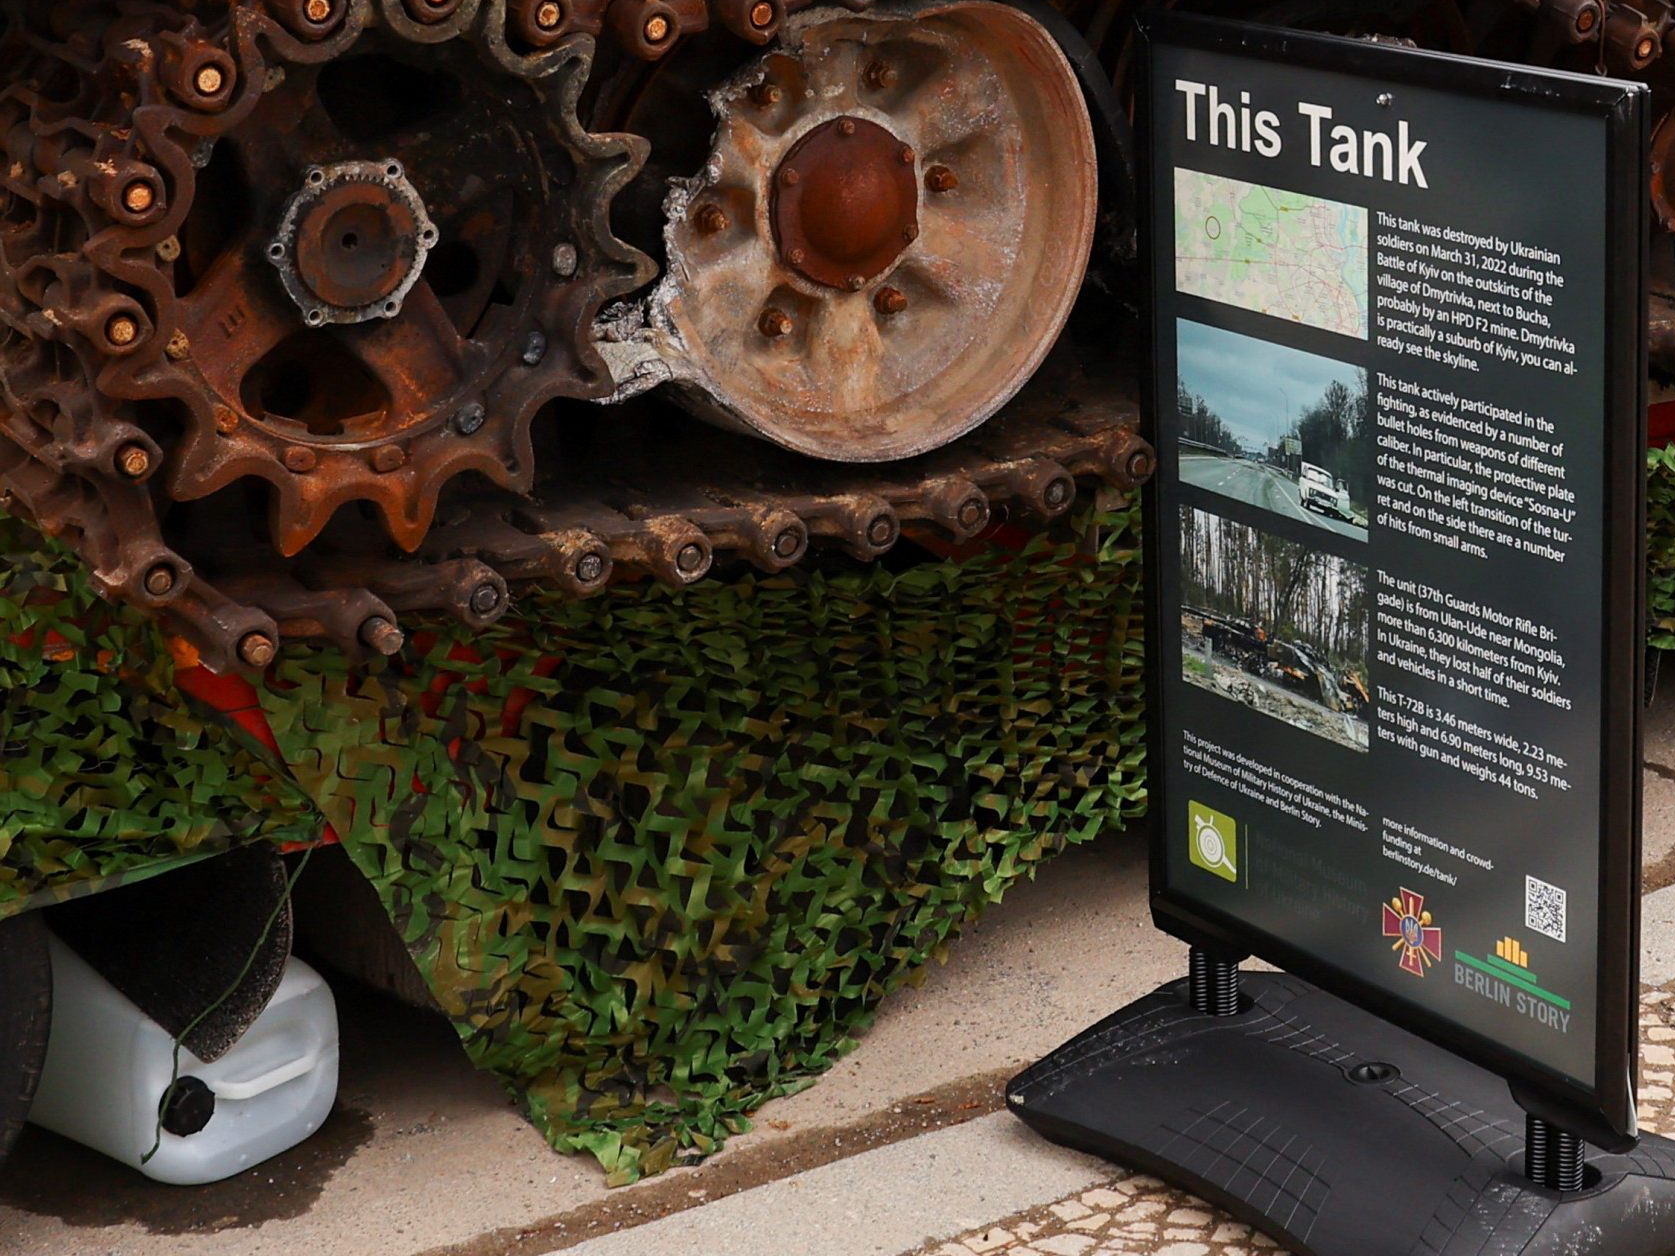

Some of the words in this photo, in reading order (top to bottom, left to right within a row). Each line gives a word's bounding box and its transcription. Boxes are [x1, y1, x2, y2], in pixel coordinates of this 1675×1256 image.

[1175, 79, 1282, 157] This
[1298, 101, 1429, 189] Tank
[1376, 210, 1397, 228] This
[1397, 217, 1420, 234] tank
[1421, 224, 1442, 238] was
[1442, 225, 1493, 250] destroyed
[1495, 236, 1509, 256] by
[1510, 240, 1561, 265] Ukrainian
[1376, 233, 1414, 253] soldiers
[1415, 243, 1429, 256] on
[1430, 243, 1462, 264] March
[1463, 251, 1480, 269] 31,
[1480, 255, 1507, 274] 2022
[1508, 261, 1544, 286] during
[1545, 270, 1564, 287] the
[1376, 251, 1405, 271] Battle
[1406, 259, 1418, 274] of
[1418, 261, 1440, 279] Kyiv
[1440, 269, 1455, 283] on
[1456, 270, 1474, 287] the
[1474, 278, 1520, 298] outskirts
[1521, 286, 1534, 301] of
[1534, 288, 1553, 306] the
[1376, 273, 1409, 294] village
[1409, 280, 1421, 295] of
[1422, 282, 1476, 310] Dmytrivka,
[1477, 299, 1501, 315] next
[1502, 303, 1514, 318] to
[1515, 305, 1551, 329] Bucha,
[1376, 295, 1421, 318] probably
[1422, 302, 1435, 322] by
[1435, 309, 1450, 322] an
[1451, 310, 1474, 328] HPD
[1475, 316, 1488, 333] F2
[1489, 322, 1519, 340] mine.
[1520, 327, 1575, 354] Dmytrivka
[1376, 312, 1385, 327] is
[1386, 317, 1436, 342] practically
[1436, 330, 1444, 341] a
[1445, 331, 1482, 351] suburb
[1482, 340, 1495, 354] of
[1495, 342, 1519, 363] Kyiv,
[1520, 351, 1541, 367] you
[1542, 357, 1562, 372] can
[1563, 360, 1578, 375] al-
[1376, 335, 1405, 354] ready
[1405, 342, 1423, 357] see
[1423, 344, 1441, 362] the
[1442, 349, 1480, 372] skyline.
[1376, 685, 1397, 704] This
[1397, 693, 1424, 715] T-72B
[1425, 704, 1434, 719] is
[1435, 707, 1456, 727] 3.46
[1457, 719, 1492, 741] meters
[1493, 732, 1521, 754] wide,
[1522, 741, 1544, 761] 2.23
[1545, 753, 1568, 769] me-
[1377, 706, 1395, 723] ters
[1396, 711, 1419, 733] high
[1419, 724, 1439, 740] and
[1440, 730, 1462, 749] 6.90
[1462, 741, 1498, 763] meters
[1498, 751, 1525, 776] long,
[1525, 763, 1548, 783] 9.53
[1549, 775, 1572, 791] me-
[1377, 725, 1395, 742] ters
[1396, 734, 1418, 751] with
[1419, 743, 1439, 760] gun
[1440, 751, 1460, 768] and
[1461, 759, 1497, 783] weighs
[1498, 773, 1512, 788] 44
[1512, 778, 1539, 800] tons.
[1382, 829, 1413, 854] funding
[1413, 845, 1422, 856] at
[1382, 817, 1403, 833] more
[1403, 823, 1449, 852] information
[1449, 845, 1466, 859] and
[1465, 852, 1494, 870] crowd-
[1382, 844, 1457, 886] berlinstory.de/tank/
[1454, 962, 1510, 1007] BERLIN
[1516, 991, 1570, 1033] STORY
